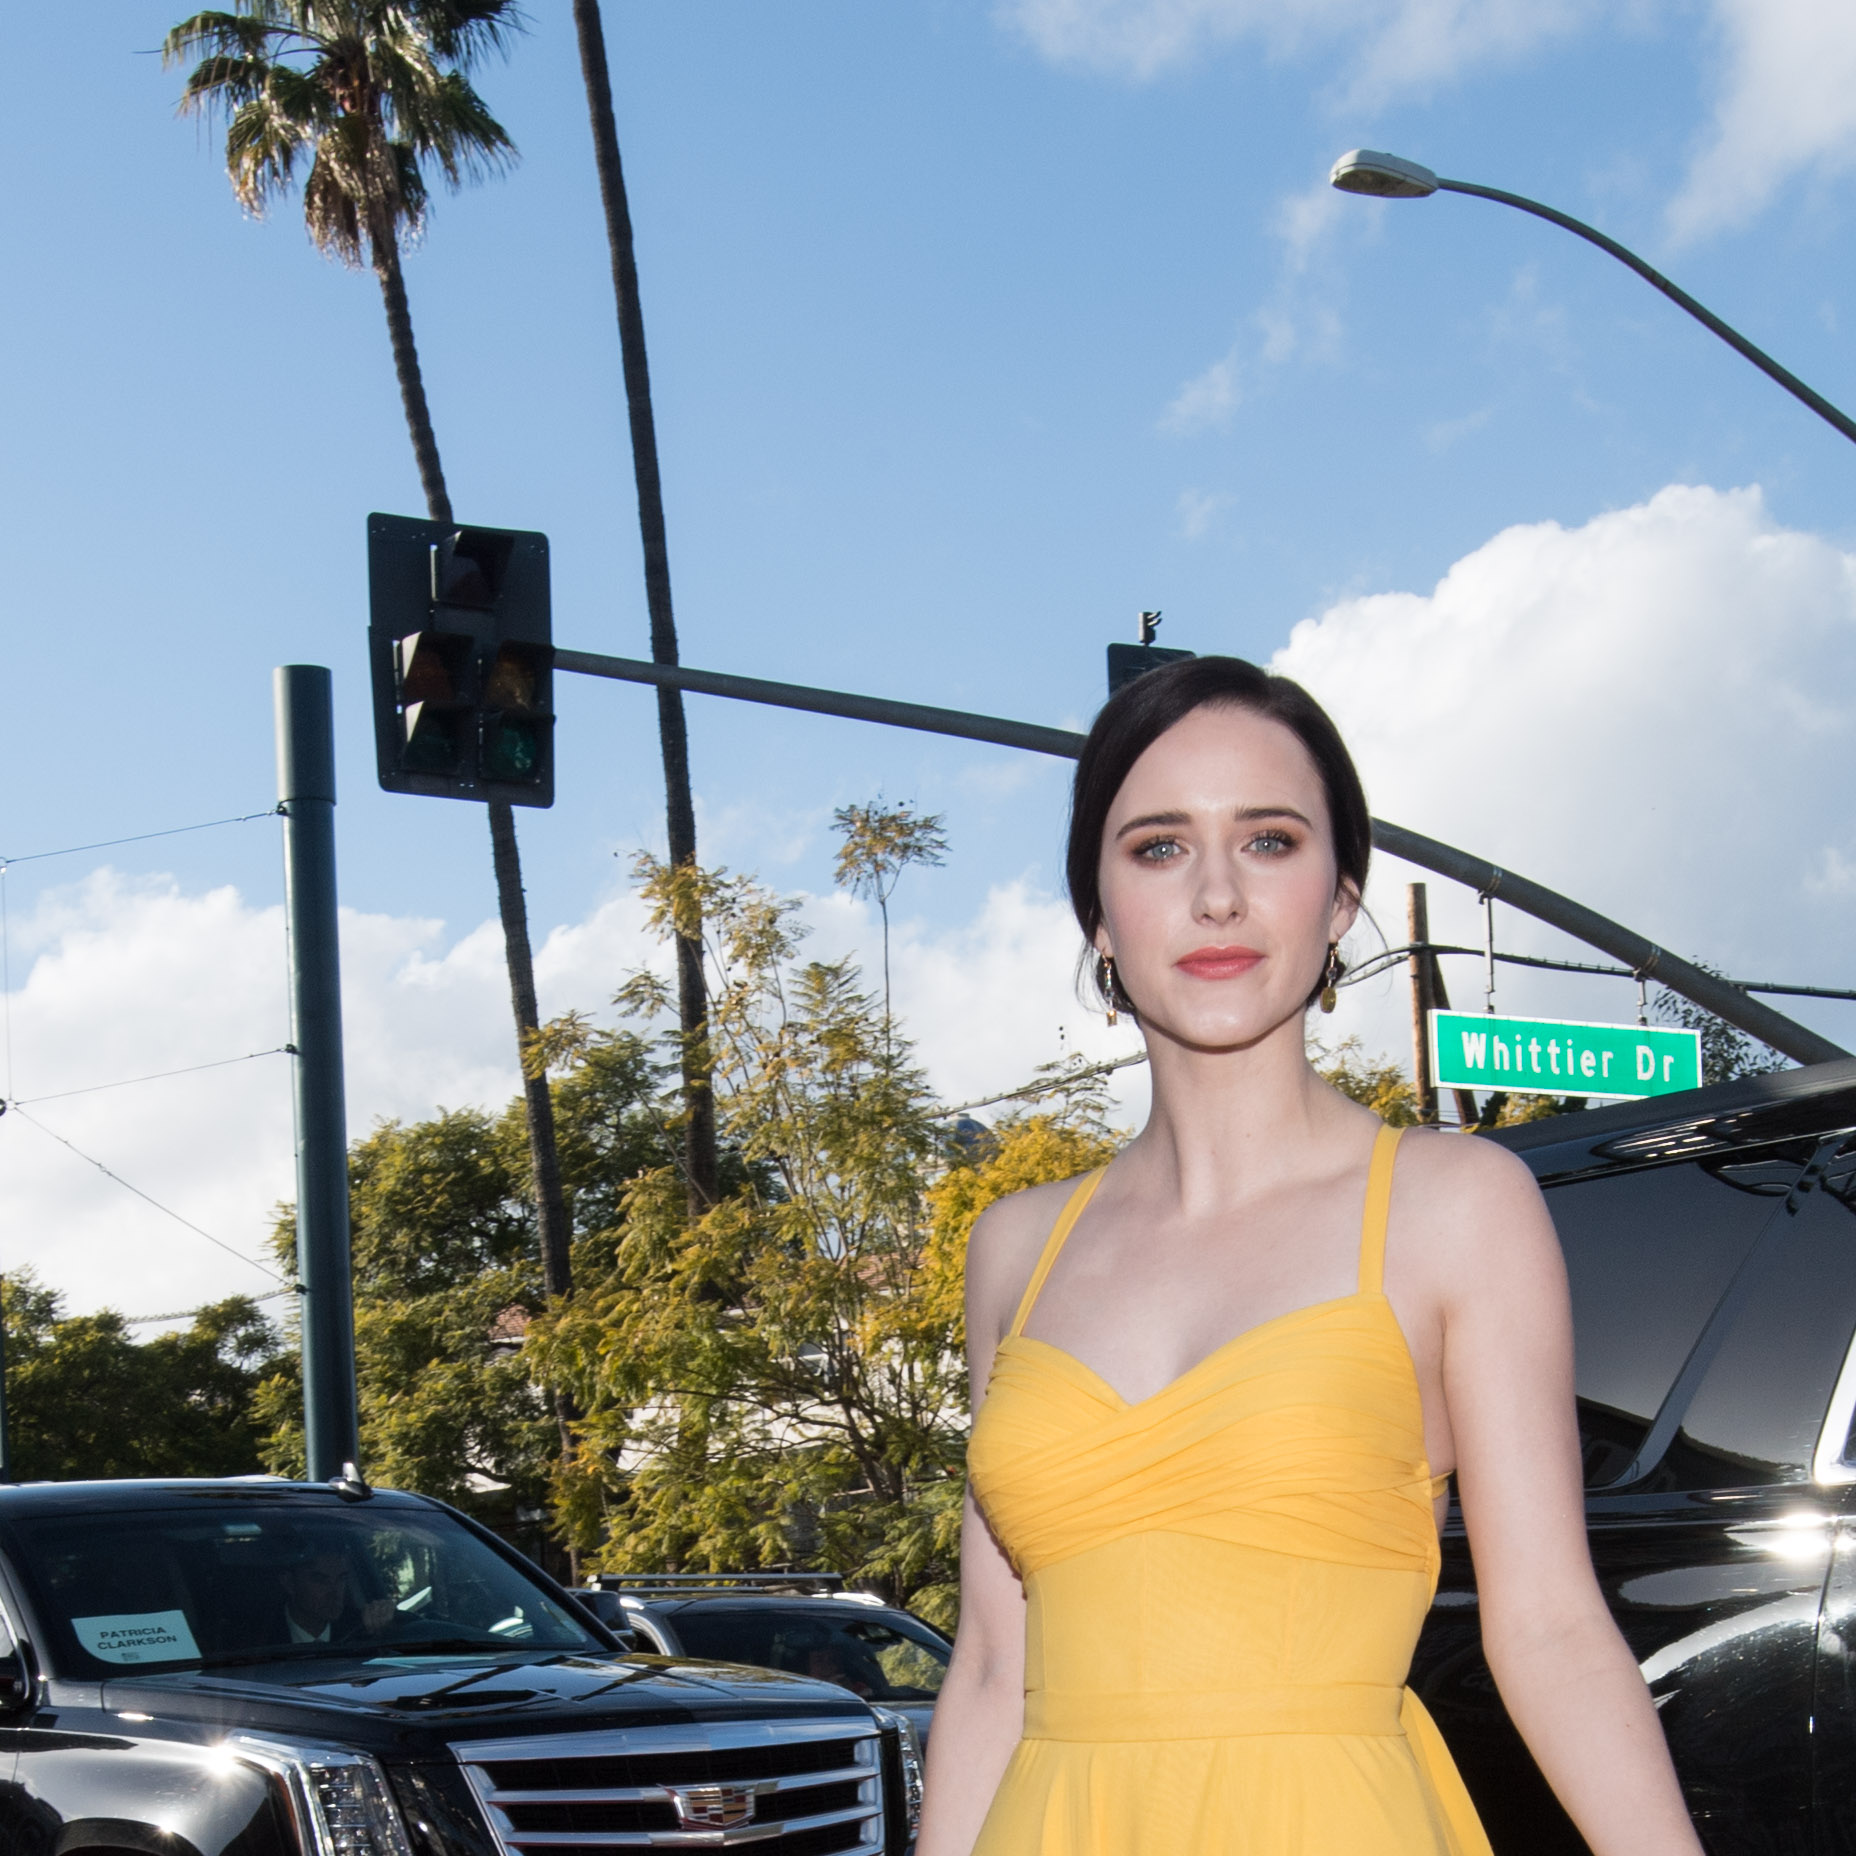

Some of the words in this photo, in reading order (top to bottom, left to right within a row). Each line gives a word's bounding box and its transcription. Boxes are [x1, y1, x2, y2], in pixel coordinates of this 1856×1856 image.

[1461, 1031, 1614, 1078] Whittier
[1636, 1045, 1674, 1082] Dr
[99, 1626, 166, 1640] PATRICIA
[97, 1635, 177, 1650] CLARKSON
